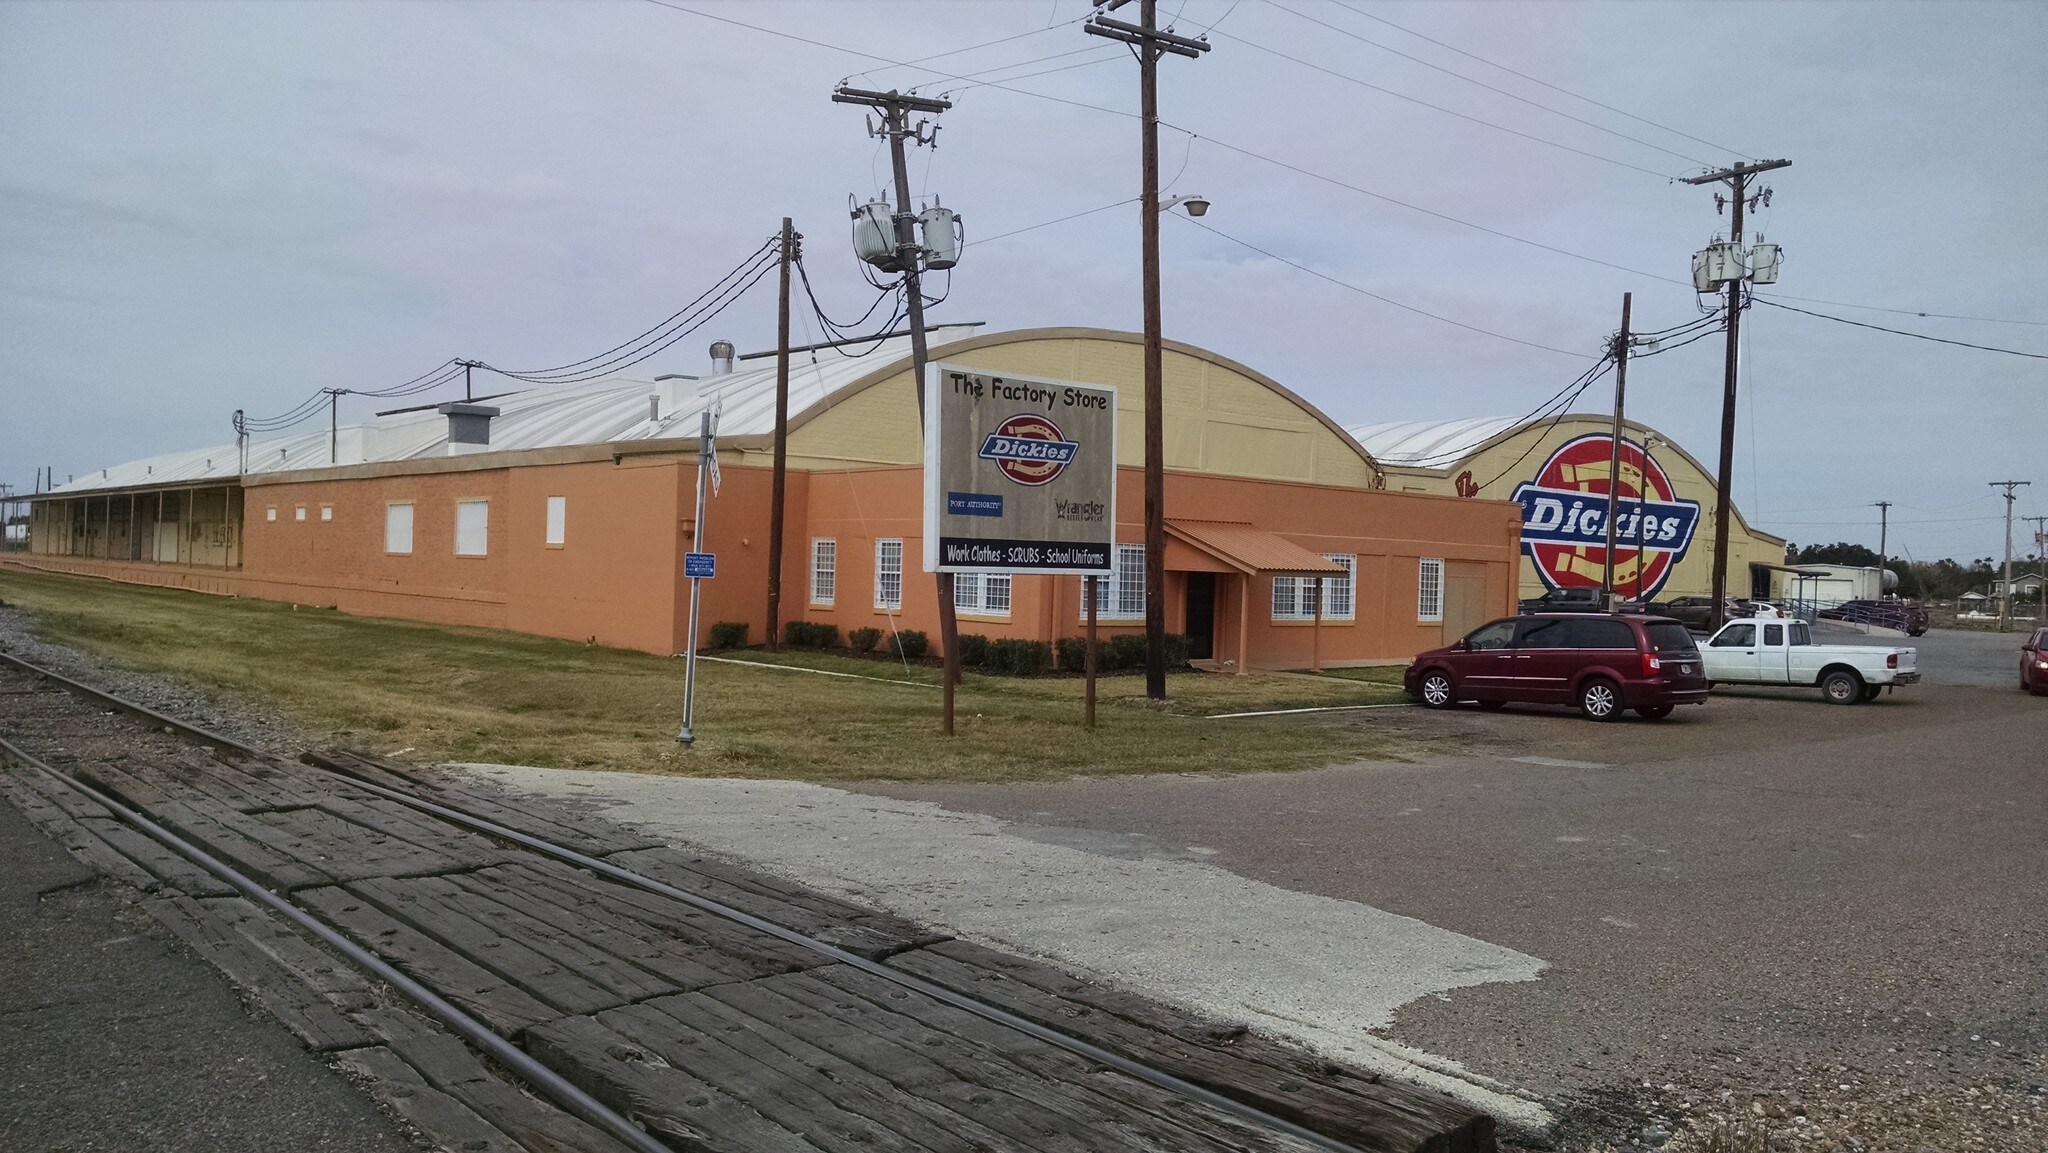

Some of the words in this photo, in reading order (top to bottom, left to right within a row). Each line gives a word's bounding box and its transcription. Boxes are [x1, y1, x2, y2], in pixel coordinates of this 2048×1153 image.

[950, 373, 983, 397] The
[992, 377, 1056, 410] Factory
[1064, 388, 1107, 410] Store
[991, 439, 1069, 459] Dickies
[950, 499, 965, 508] PORT
[967, 501, 999, 510] AUTHORITY
[1055, 499, 1104, 516] Wrangler
[1524, 498, 1680, 541] Dickies
[947, 544, 970, 563] Work
[971, 545, 1001, 563] Clothes
[1008, 547, 1039, 564] SCRUBS
[1046, 548, 1071, 565] School
[1072, 548, 1104, 566] Uniforms
